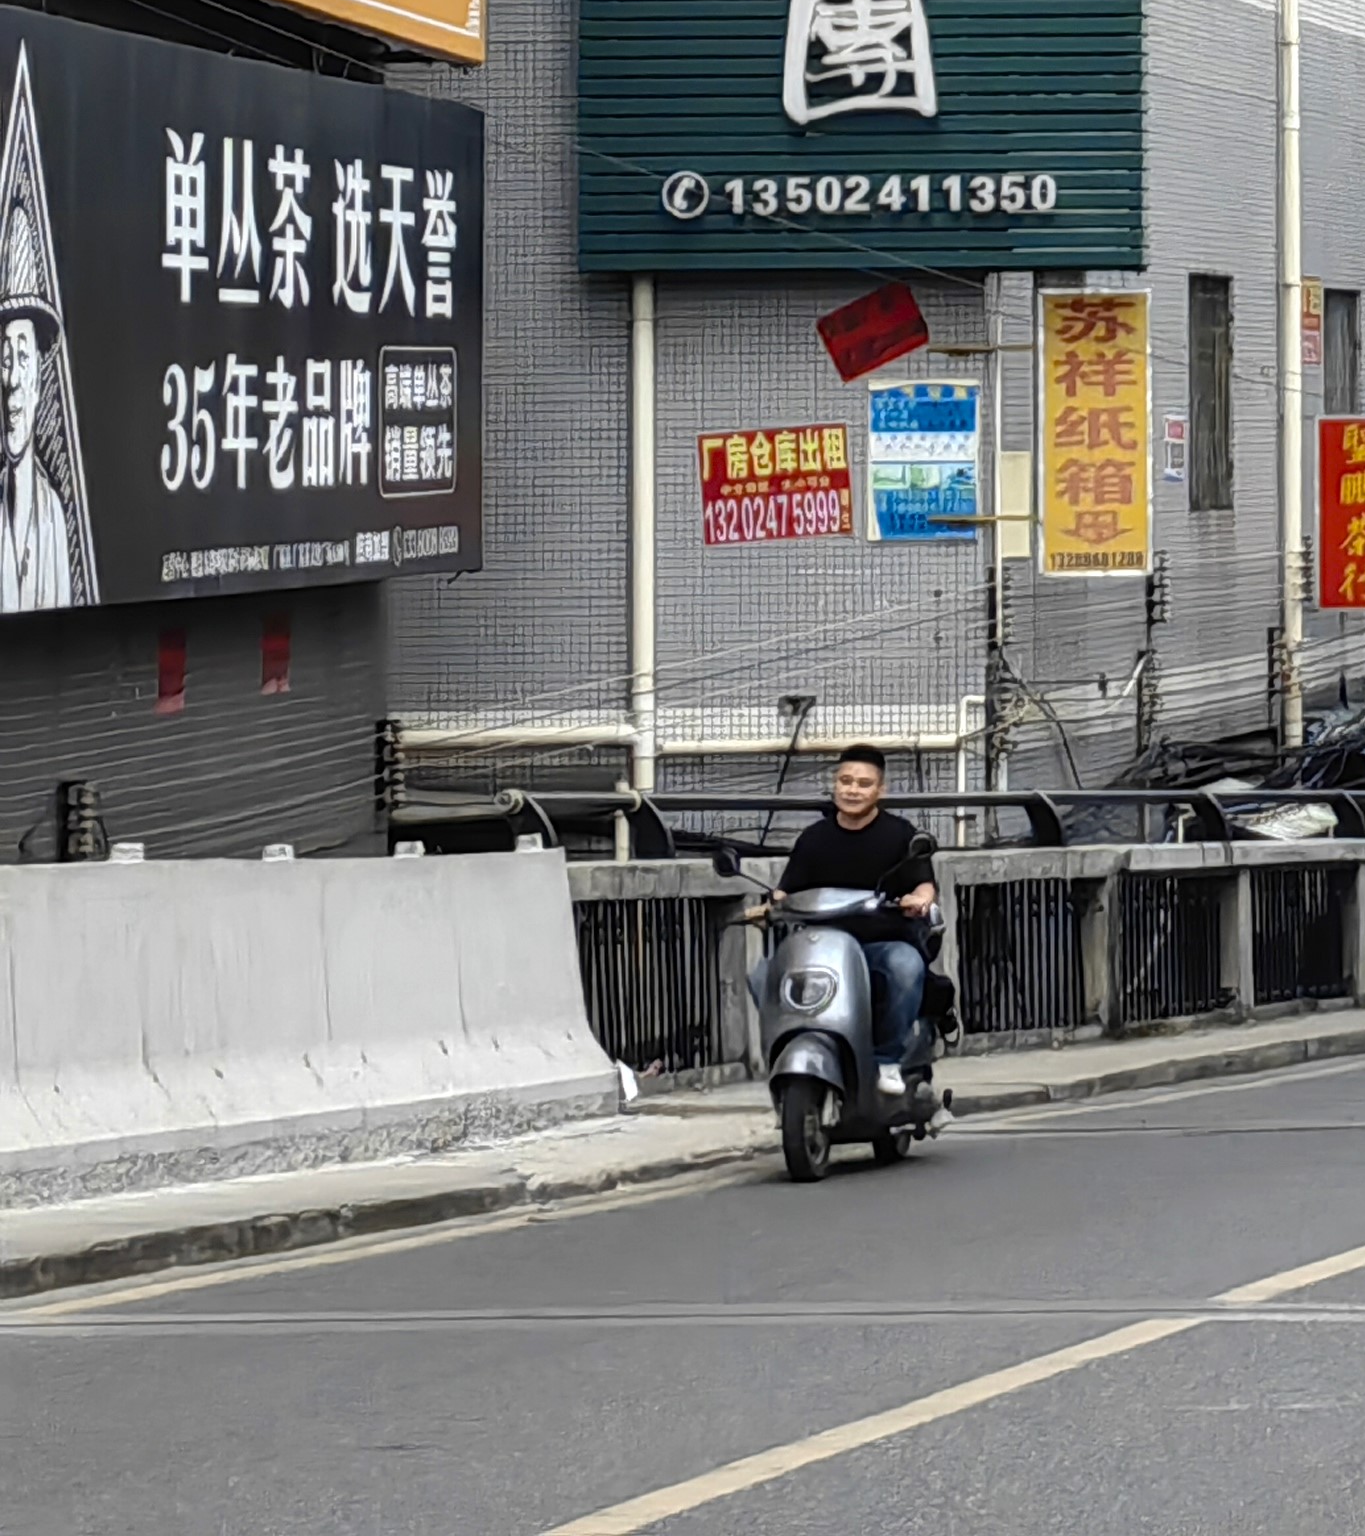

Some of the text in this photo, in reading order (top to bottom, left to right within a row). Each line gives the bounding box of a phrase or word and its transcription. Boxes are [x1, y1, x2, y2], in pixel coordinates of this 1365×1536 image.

[724, 173, 1058, 216] 13502411350
[161, 352, 373, 493] 35年老品牌
[1053, 297, 1138, 506] 苏祥纸箱
[701, 427, 847, 482] 厂房仓库出租
